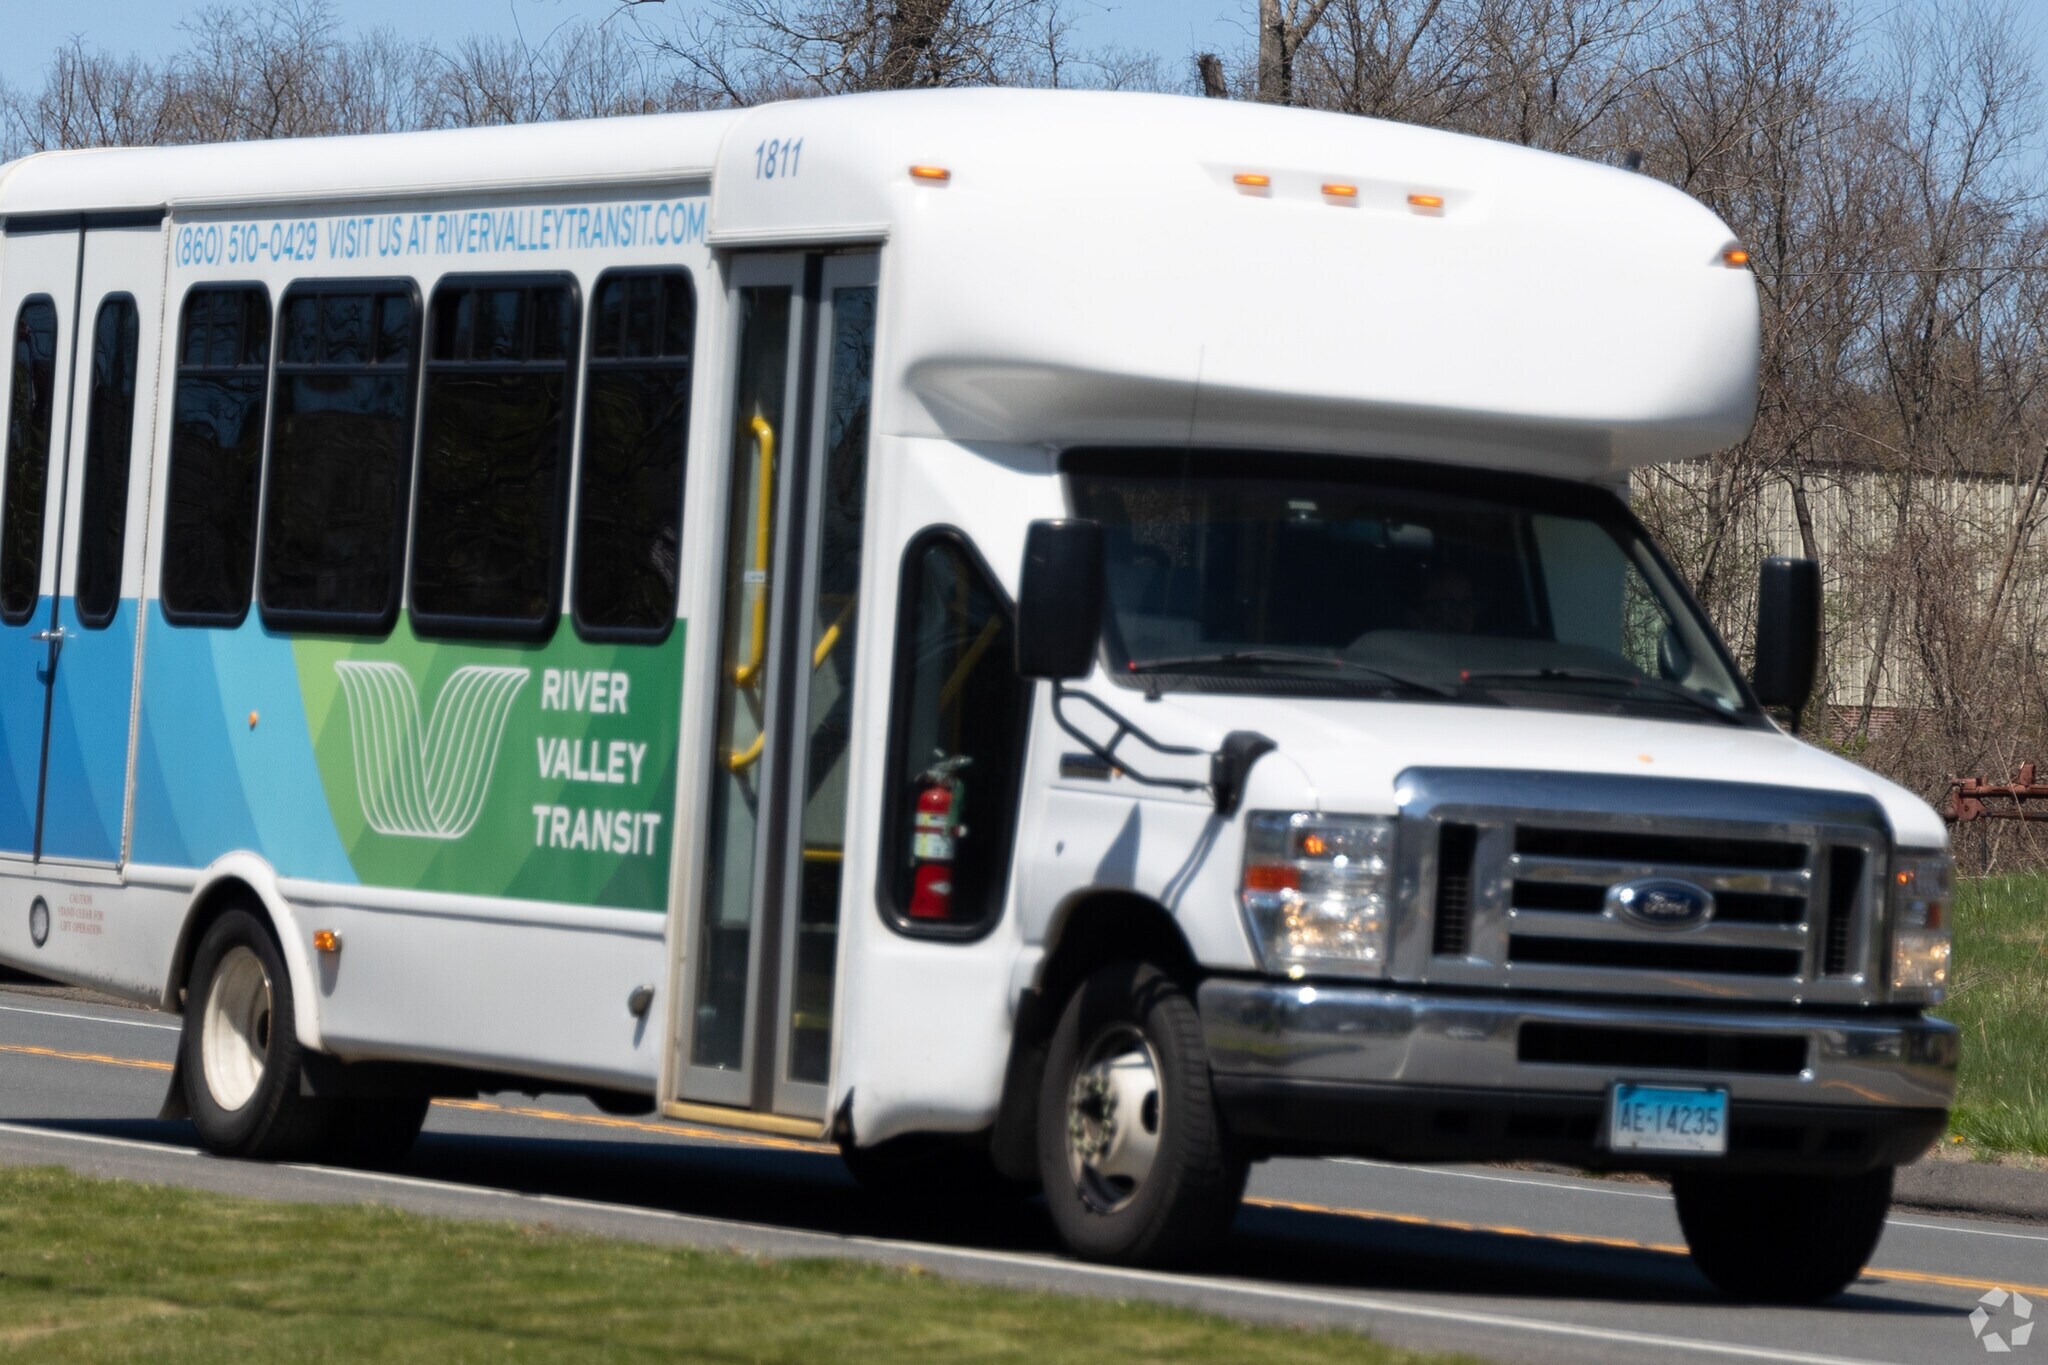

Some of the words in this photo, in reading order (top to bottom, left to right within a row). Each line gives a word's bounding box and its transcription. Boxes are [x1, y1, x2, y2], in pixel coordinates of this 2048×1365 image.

[755, 136, 804, 180] 1811
[176, 226, 223, 268] (860)
[228, 221, 317, 264] 510-0429
[328, 217, 374, 259] VISIT
[378, 215, 402, 257] US
[406, 214, 432, 255] AT
[435, 201, 707, 254] RIVERVALLEYTRANSIT.COM
[541, 668, 630, 714] RIVER
[537, 737, 647, 785] VALLEY
[532, 804, 662, 856] TRANSIT
